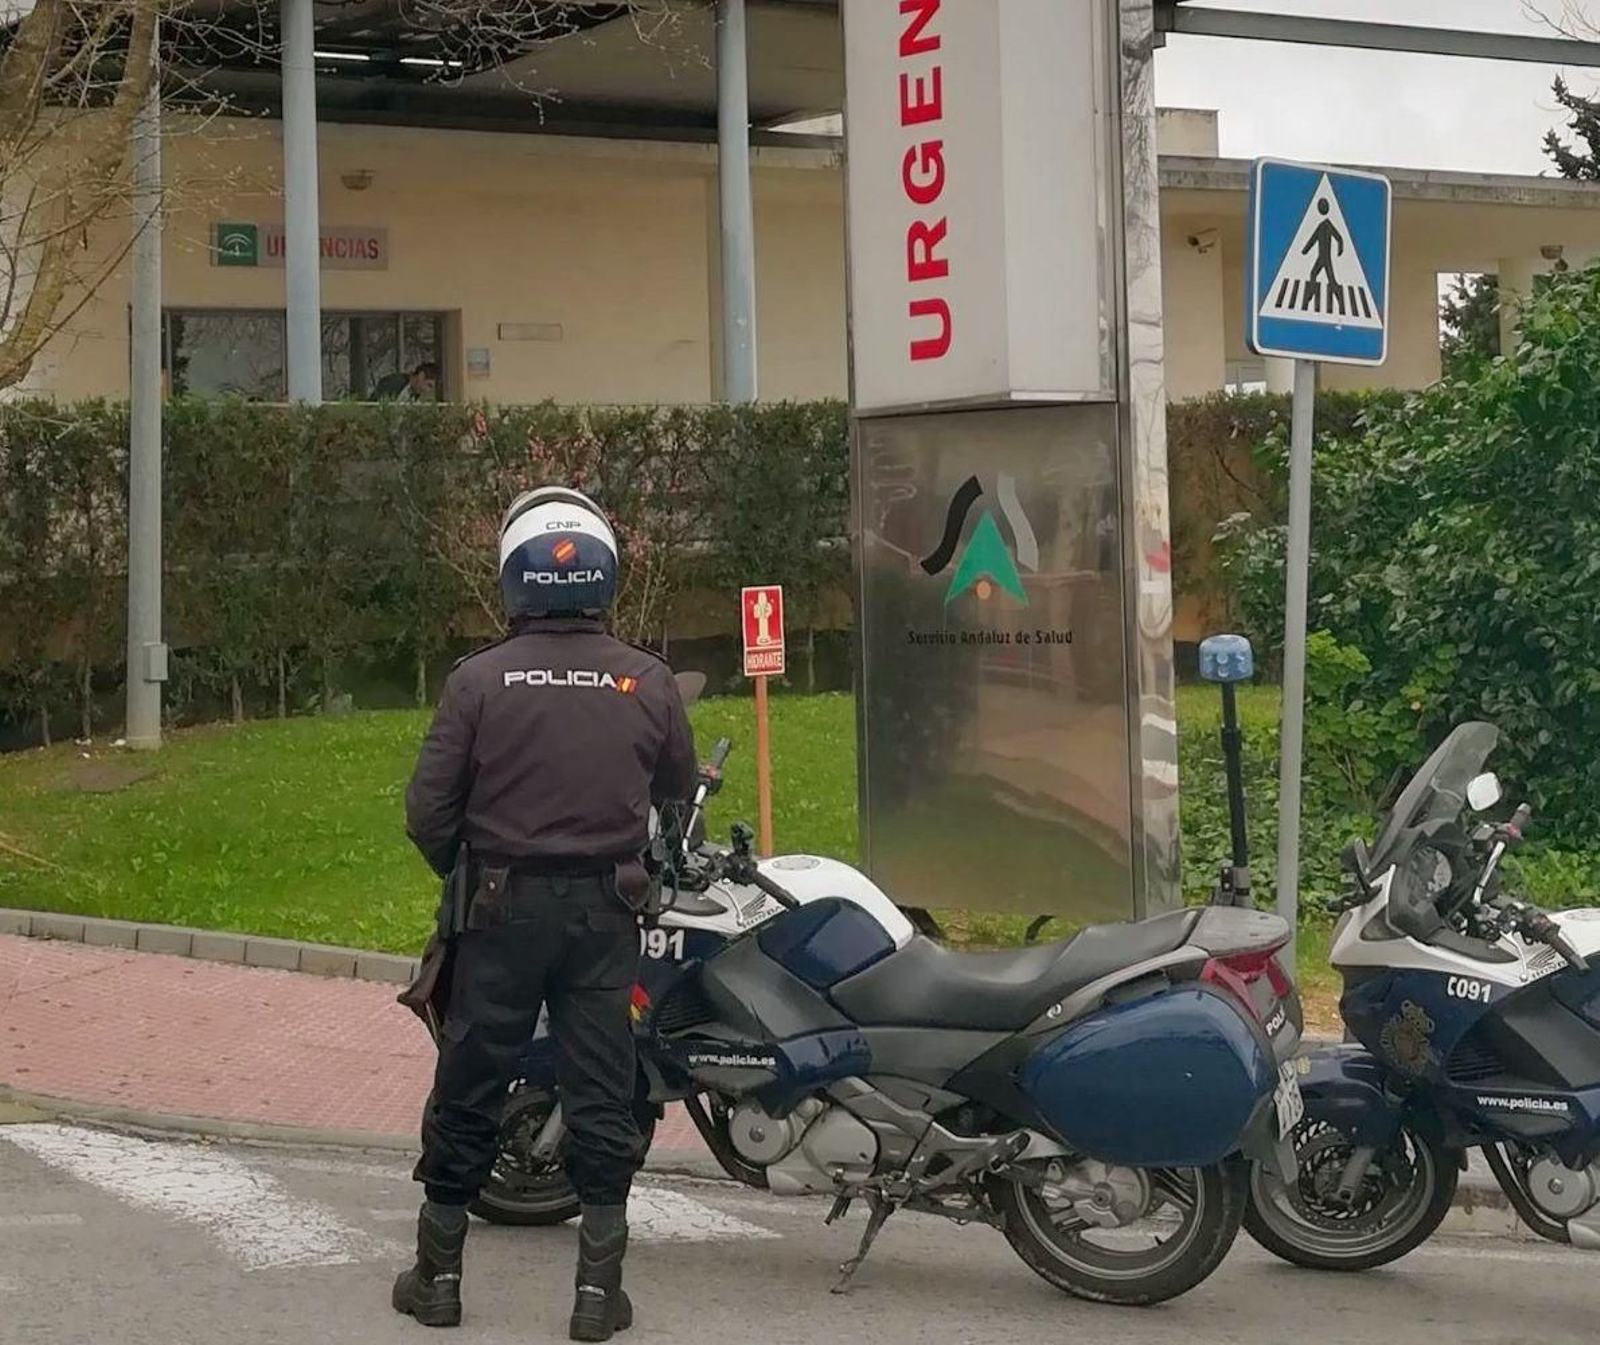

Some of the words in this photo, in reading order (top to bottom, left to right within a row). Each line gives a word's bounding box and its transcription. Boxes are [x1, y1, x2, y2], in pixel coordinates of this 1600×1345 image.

[266, 235, 379, 259] UNCIAS
[546, 521, 581, 530] CNP
[523, 569, 604, 584] POLICIA
[960, 630, 1011, 644] Andaluz
[1015, 630, 1030, 644] de
[1035, 629, 1073, 644] Salud
[504, 669, 617, 687] POLICIA
[688, 1054, 776, 1066] www.policia.es
[1477, 1096, 1568, 1111] www.policia.es
